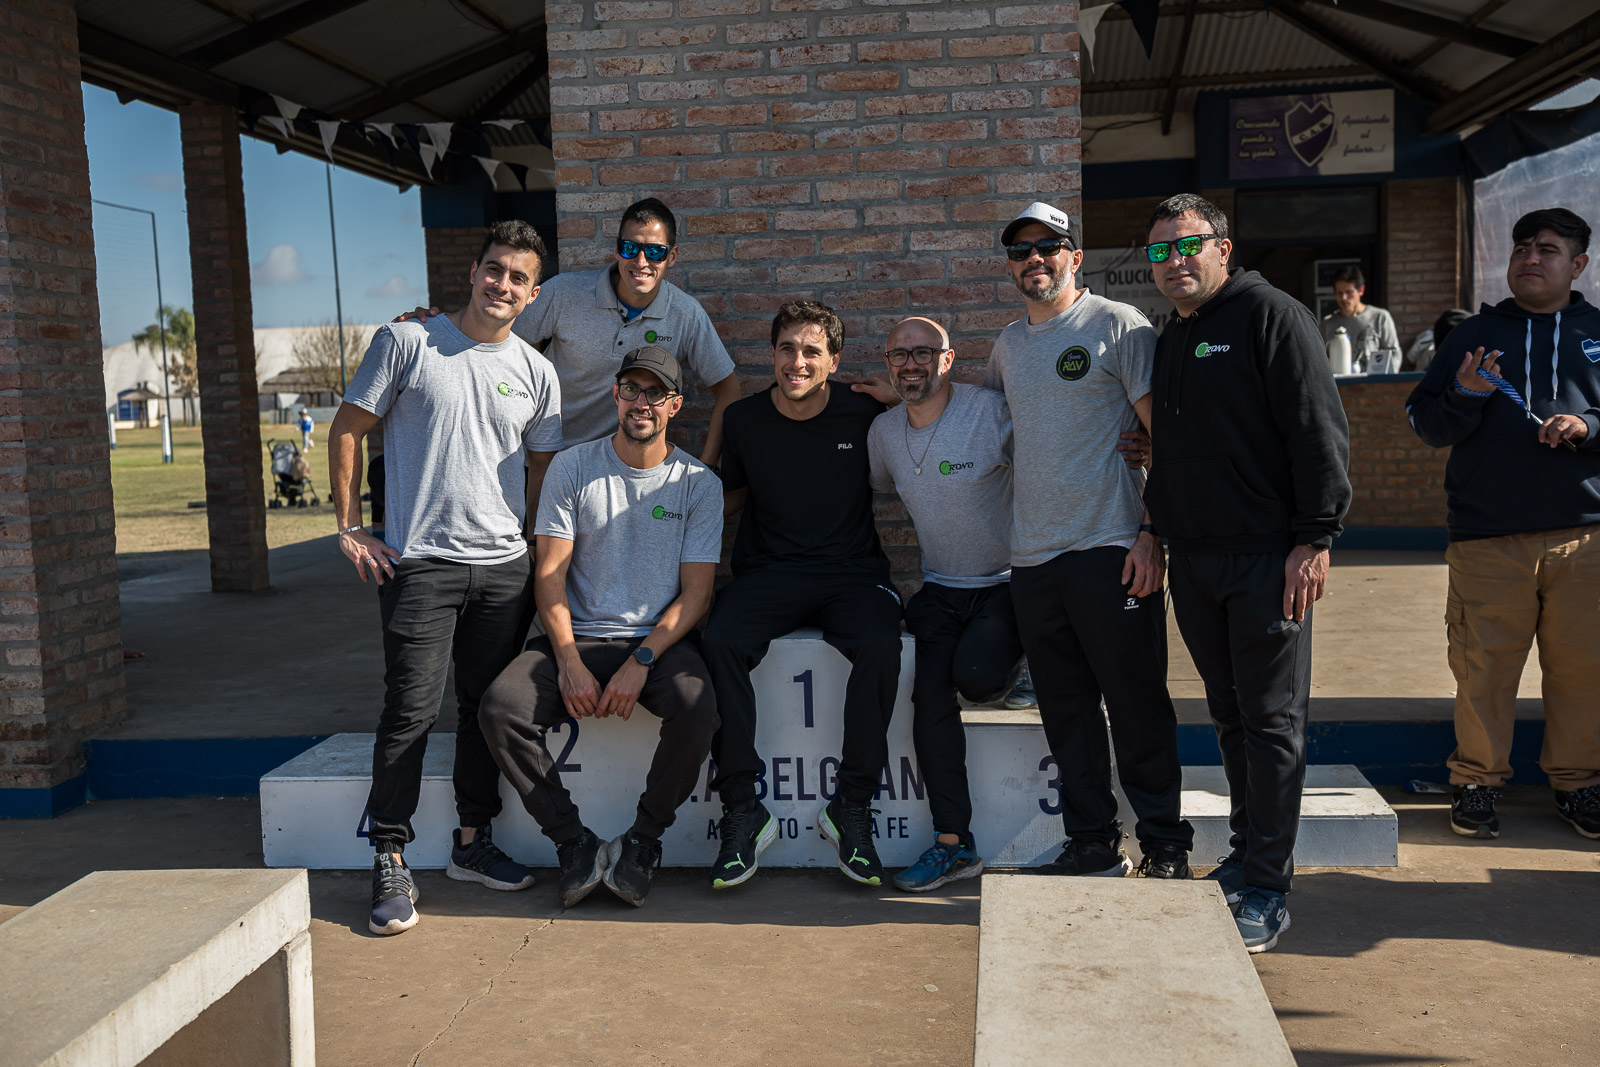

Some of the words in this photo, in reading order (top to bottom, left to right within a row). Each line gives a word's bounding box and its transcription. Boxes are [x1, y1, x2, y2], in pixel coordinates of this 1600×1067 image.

[793, 669, 815, 729] 1
[551, 716, 582, 773] 2
[1038, 754, 1063, 816] 3
[887, 817, 910, 839] FE
